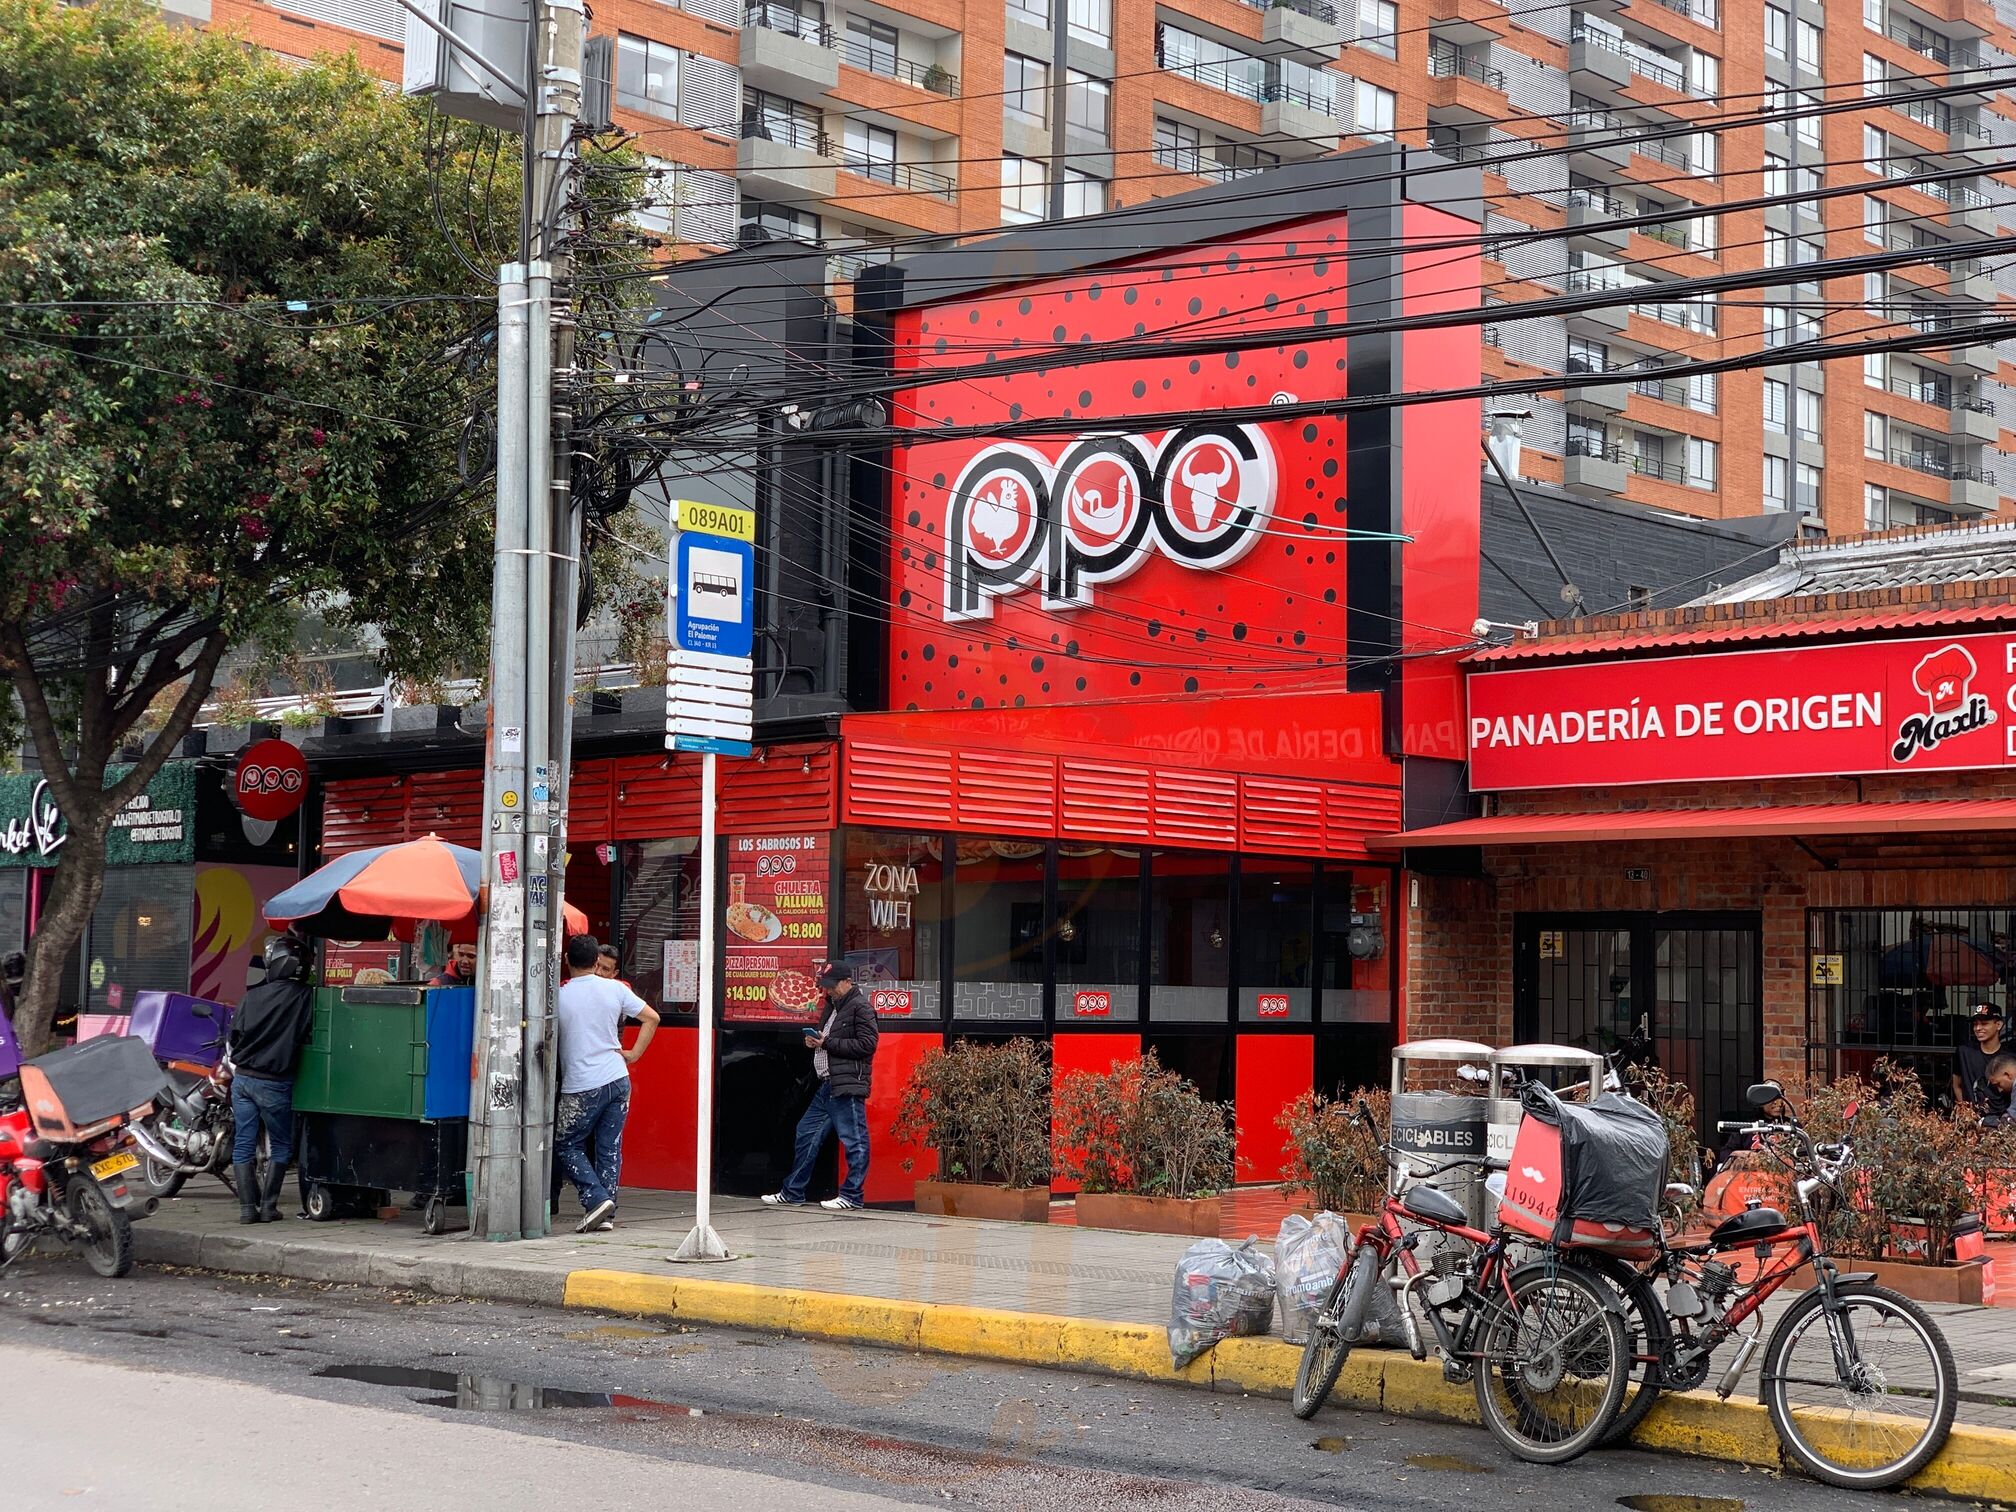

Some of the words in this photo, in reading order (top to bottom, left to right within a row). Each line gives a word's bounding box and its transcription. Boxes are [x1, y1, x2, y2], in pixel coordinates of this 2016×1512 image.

[689, 507, 744, 534] 089A01
[688, 620, 720, 631] Agrupación
[688, 630, 694, 638] El
[694, 631, 717, 641] Palomar
[1471, 697, 1665, 748] PANADERÍA
[1675, 702, 1724, 737] DE
[1733, 691, 1882, 734] ORIGEN
[1893, 698, 1987, 761] Maxli
[239, 764, 303, 794] ppc
[739, 838, 754, 852] LOS
[804, 836, 815, 849] DE
[757, 855, 796, 877] ppc
[864, 861, 919, 894] ZONA
[774, 881, 821, 895] CHULETA
[775, 896, 824, 908] VALLUNA
[869, 899, 912, 929] WIFI
[783, 923, 822, 939] $19.800
[725, 955, 744, 970] PIZZA
[745, 956, 779, 970] PERSONAL
[336, 969, 352, 978] POLLO
[727, 986, 766, 1001] $14.900
[875, 992, 910, 1010] ppc
[1078, 995, 1107, 1012] ppc
[1260, 997, 1287, 1014] ppc
